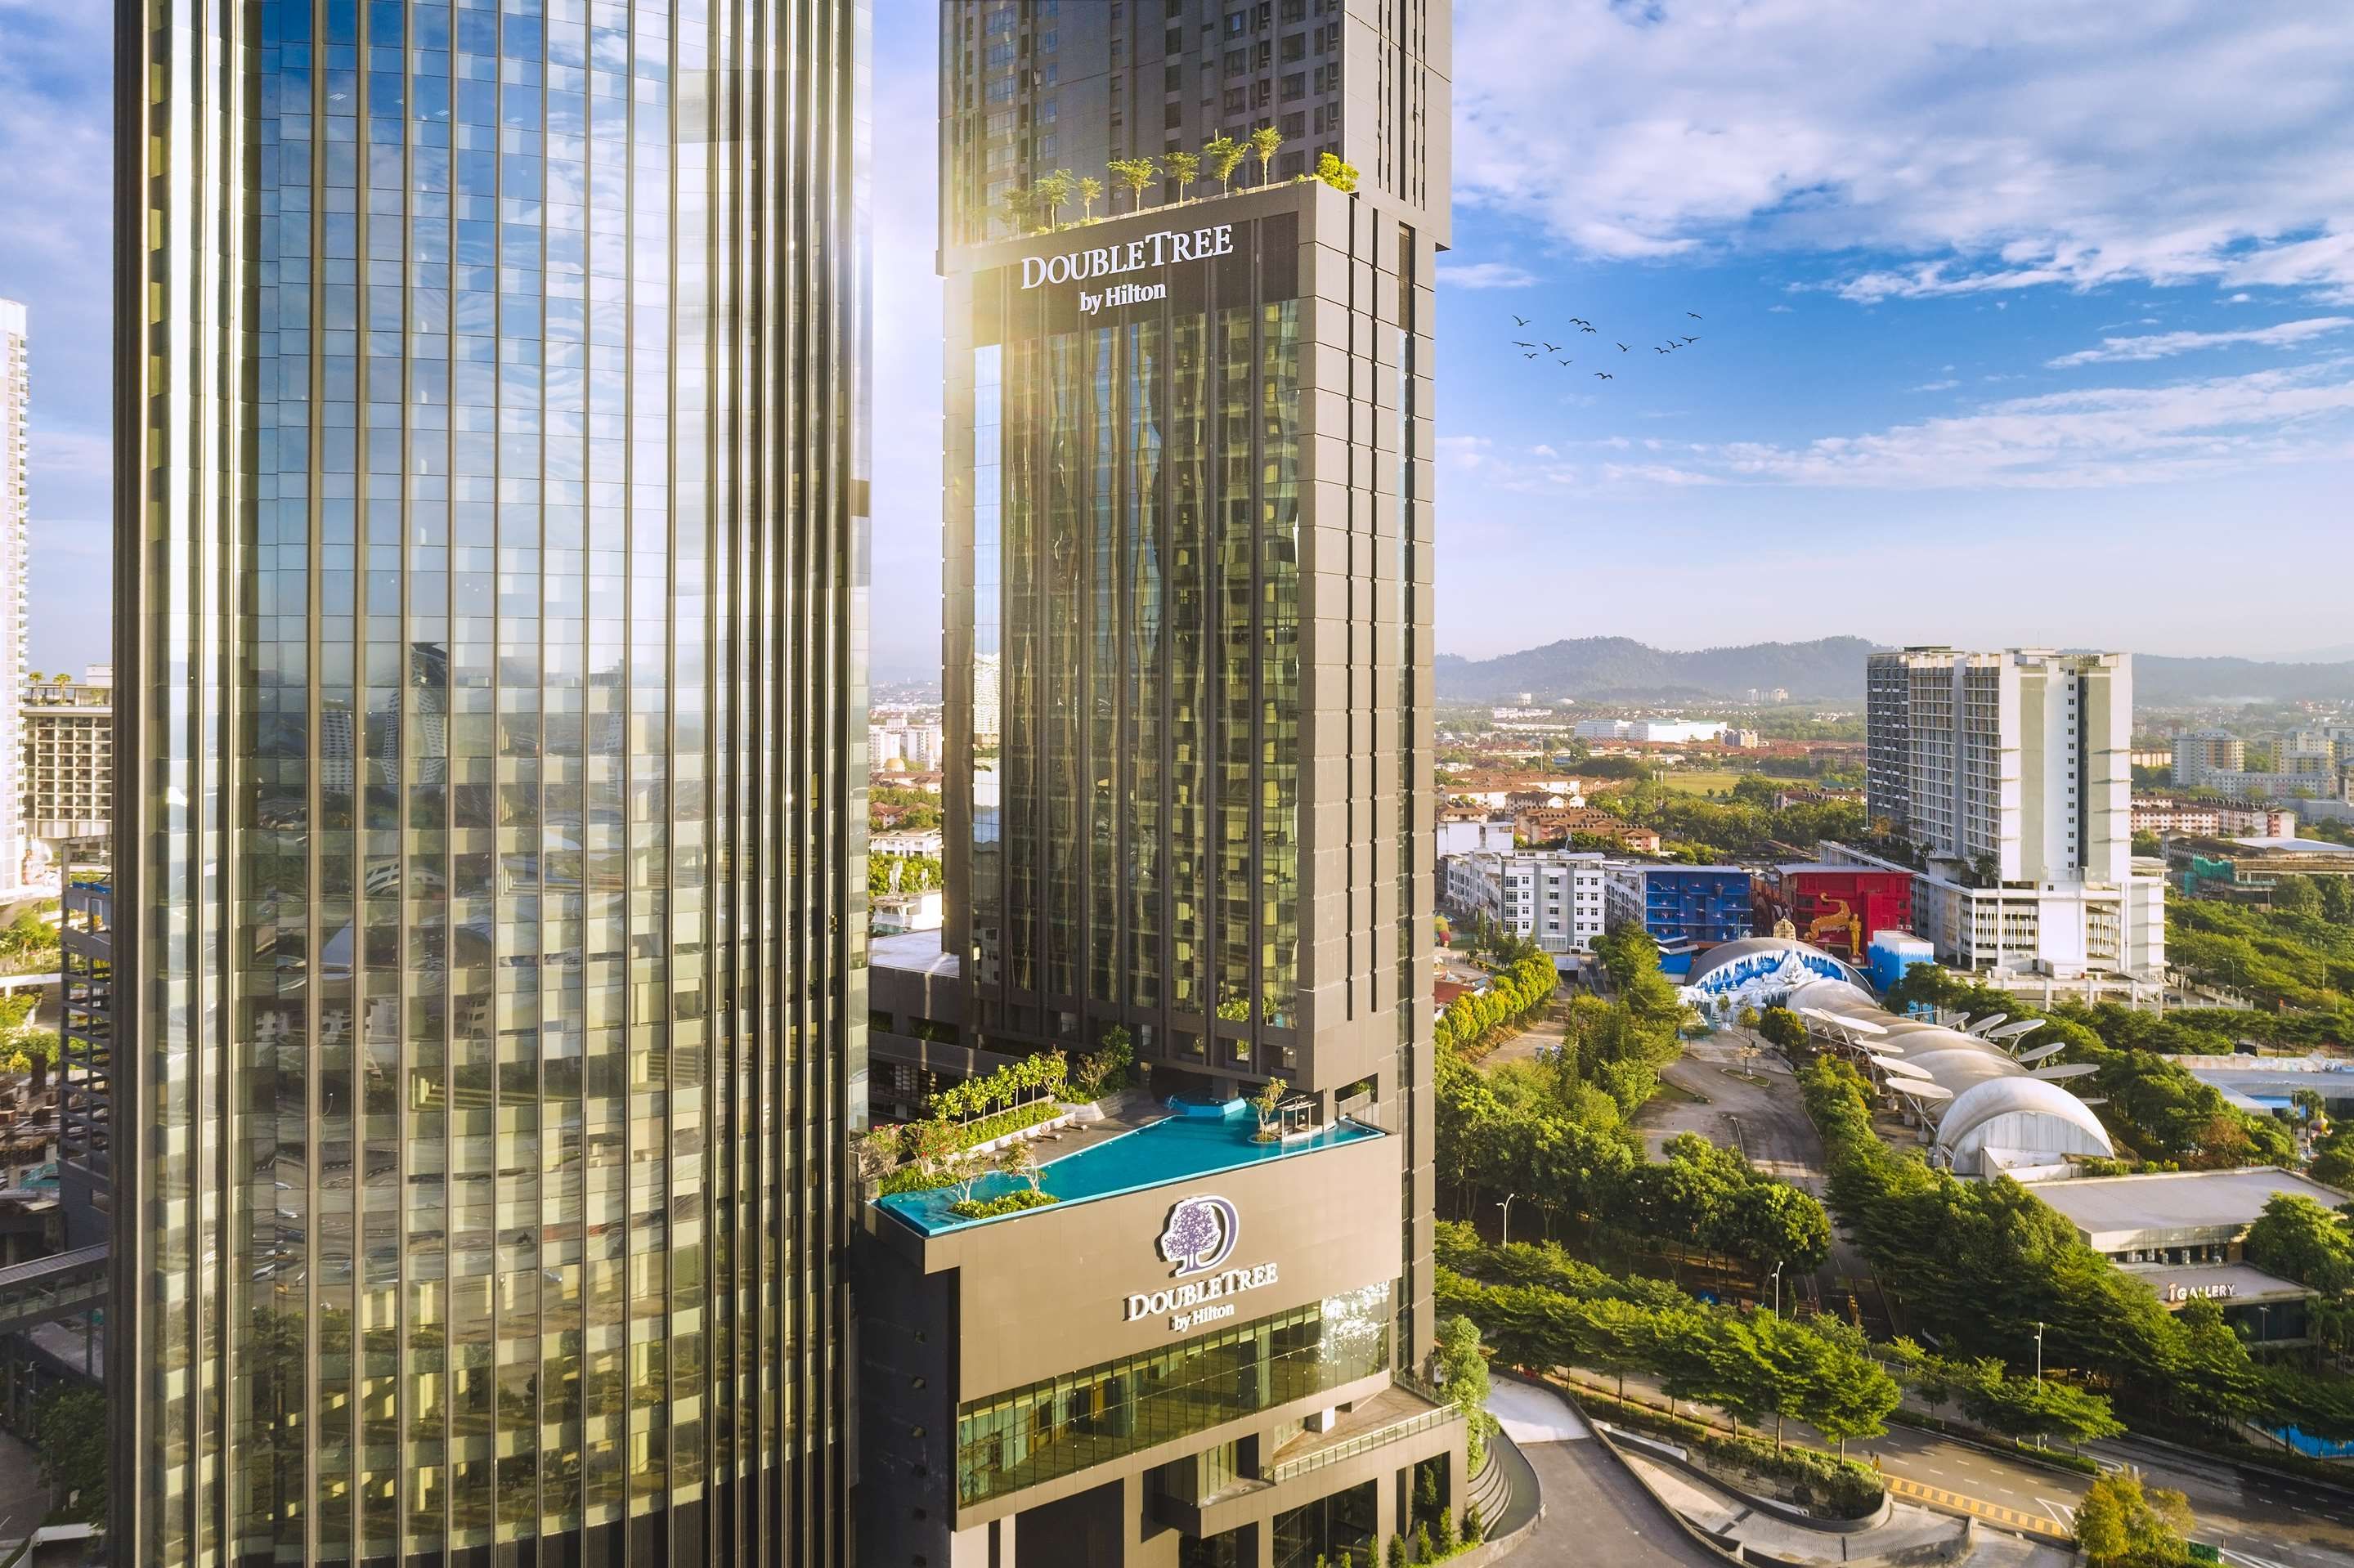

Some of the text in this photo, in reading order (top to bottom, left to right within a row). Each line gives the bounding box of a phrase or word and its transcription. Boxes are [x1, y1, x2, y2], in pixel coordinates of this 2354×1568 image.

[1079, 282, 1167, 316] by Hilton
[1173, 1303, 1235, 1333] by Hilton
